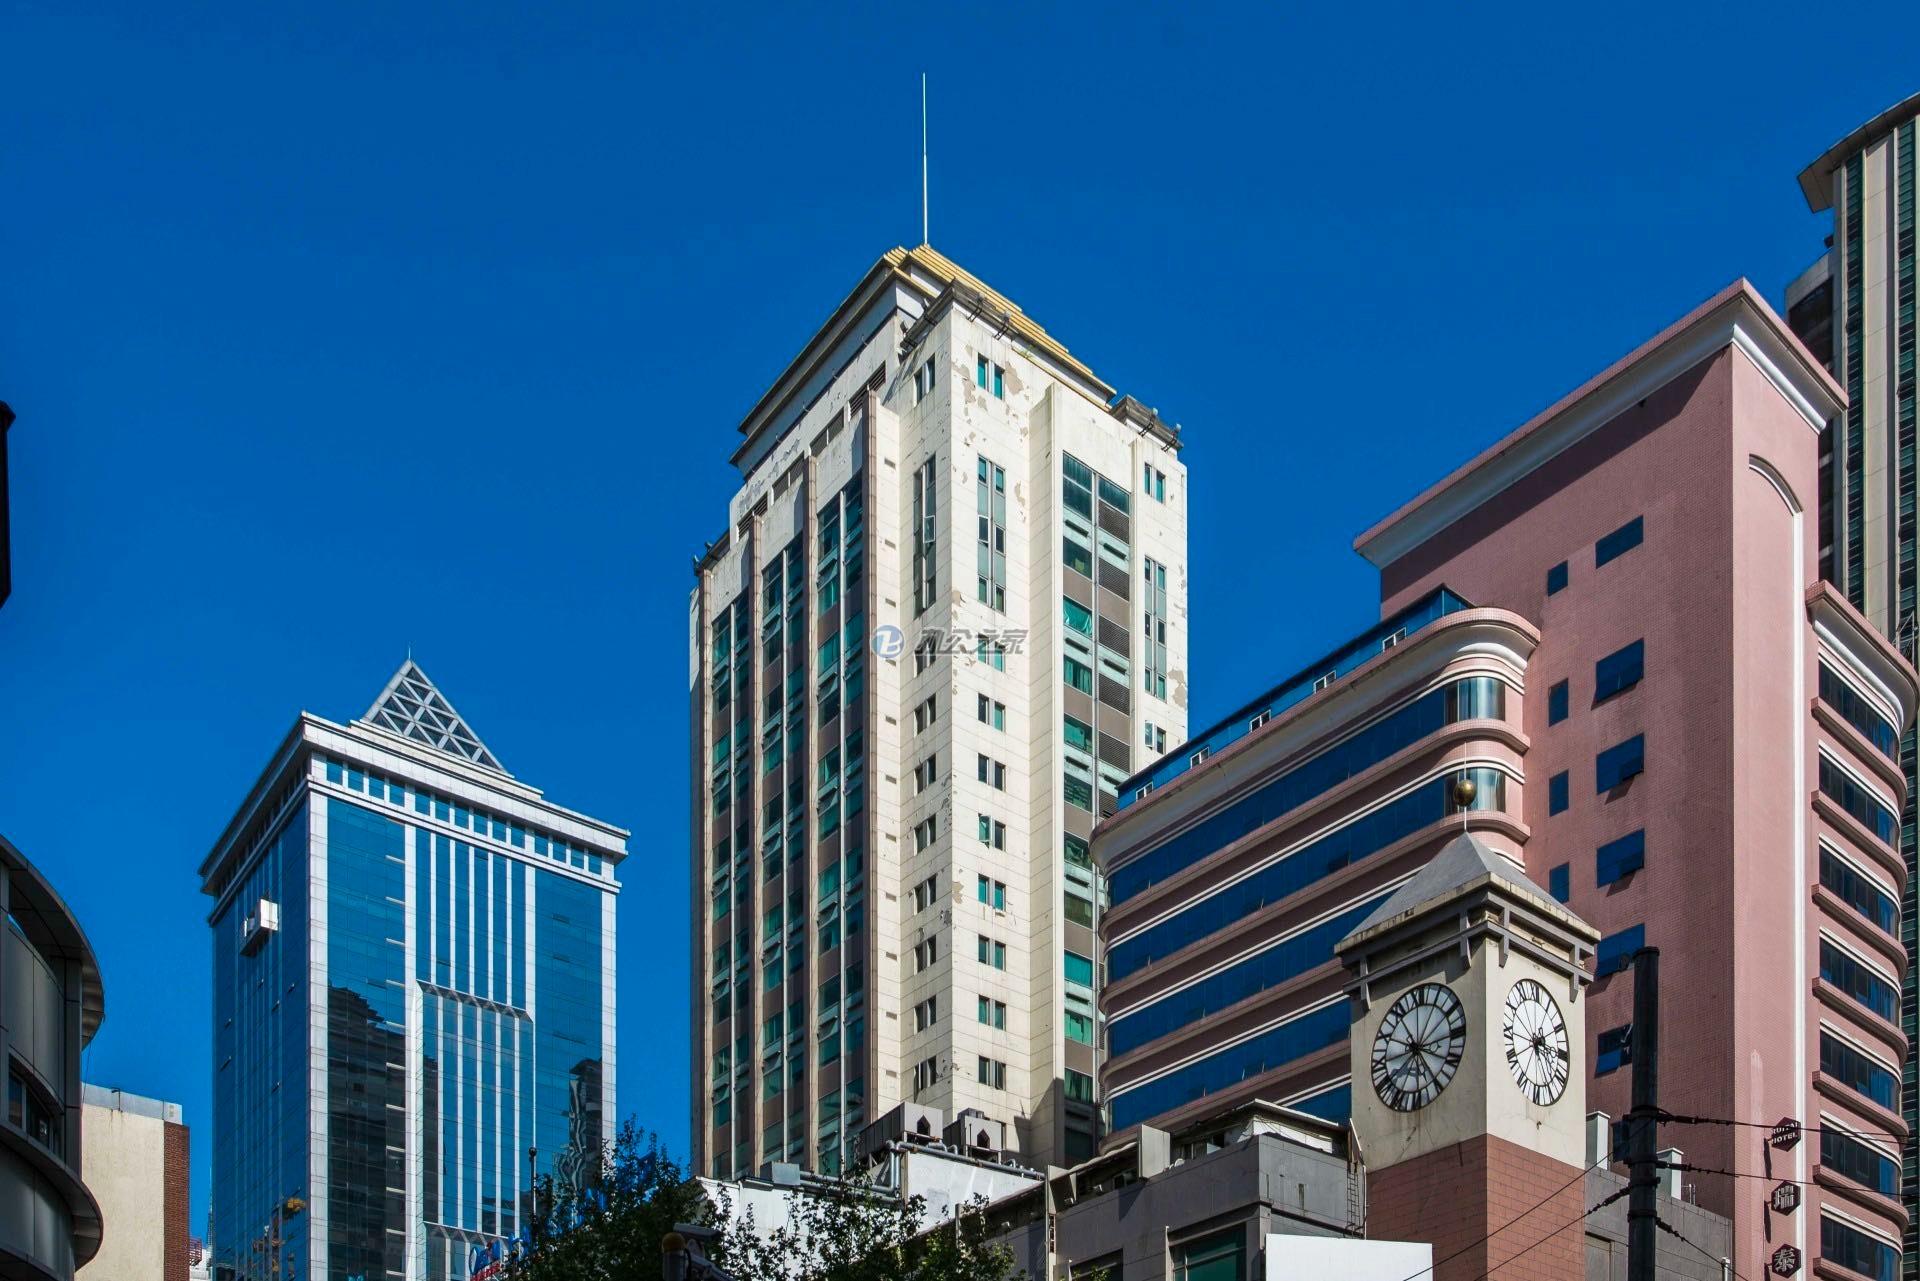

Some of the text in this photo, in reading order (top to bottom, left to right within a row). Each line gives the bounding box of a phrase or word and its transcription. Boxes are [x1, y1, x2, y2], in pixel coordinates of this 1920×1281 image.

[1771, 1132, 1797, 1144] HOTEL
[1774, 1185, 1794, 1209] 瑞
[1774, 1248, 1795, 1272] 泰
